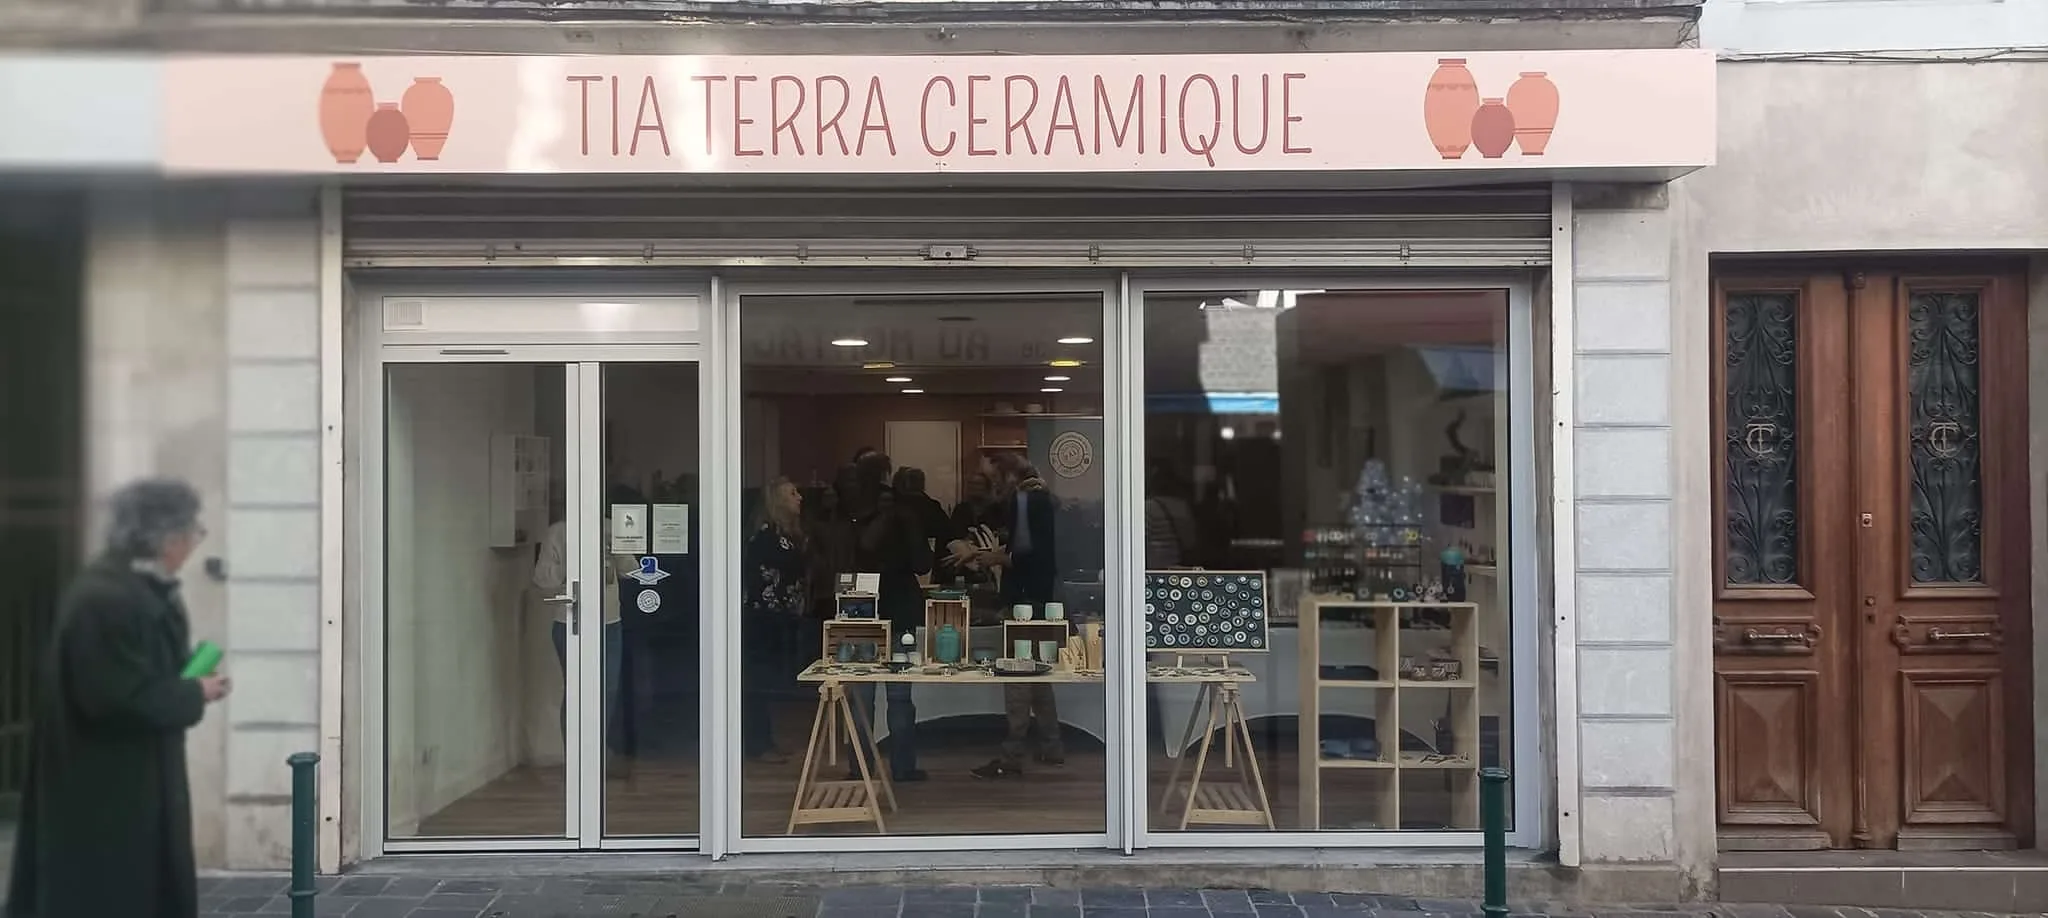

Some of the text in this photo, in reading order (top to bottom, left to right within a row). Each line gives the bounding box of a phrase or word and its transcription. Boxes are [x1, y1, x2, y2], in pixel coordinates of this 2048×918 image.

[566, 73, 1313, 167] TIA TERRA CERAMIQUE
